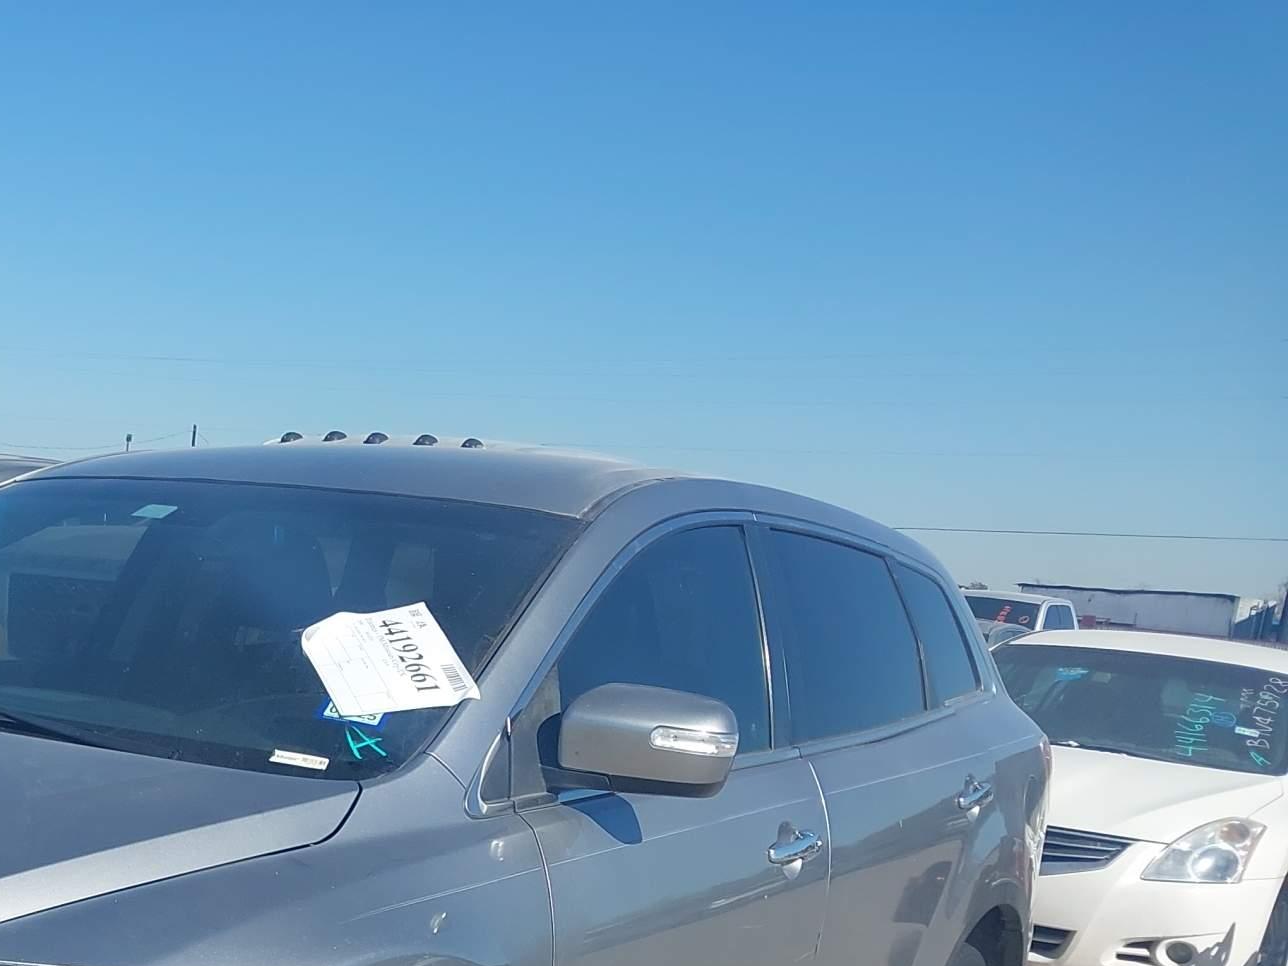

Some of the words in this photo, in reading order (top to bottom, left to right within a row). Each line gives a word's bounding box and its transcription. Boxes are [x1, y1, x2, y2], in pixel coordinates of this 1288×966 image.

[379, 620, 440, 692] 44192661
[345, 725, 387, 759] A
[1175, 692, 1225, 756] 44166314
